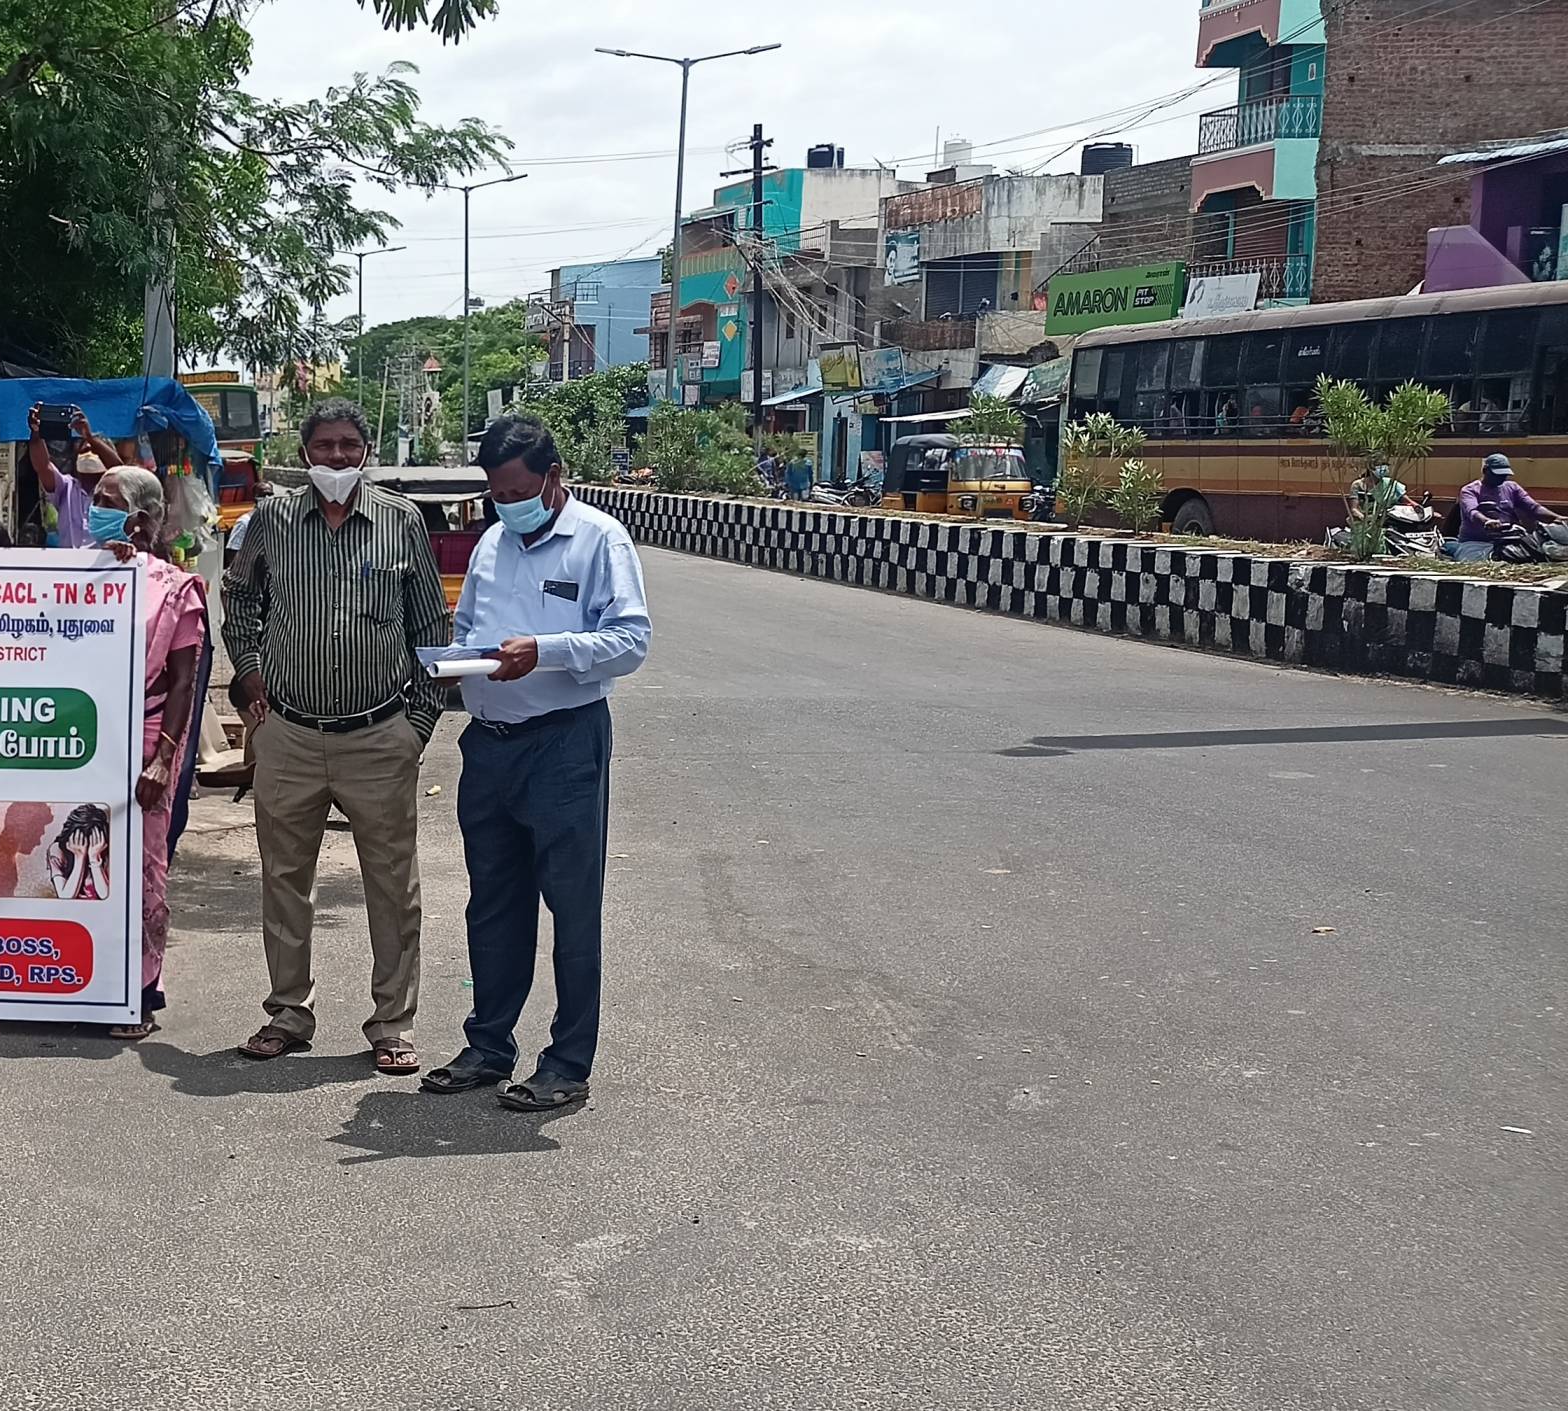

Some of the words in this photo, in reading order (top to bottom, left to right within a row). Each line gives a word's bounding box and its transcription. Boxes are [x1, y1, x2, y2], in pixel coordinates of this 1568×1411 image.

[1053, 286, 1129, 317] AMARON
[1134, 296, 1155, 306] STOP
[53, 583, 78, 604] TN
[84, 583, 96, 604] &
[103, 583, 126, 604] PY
[56, 616, 114, 640] புதுவை
[28, 965, 84, 985] RPS.
